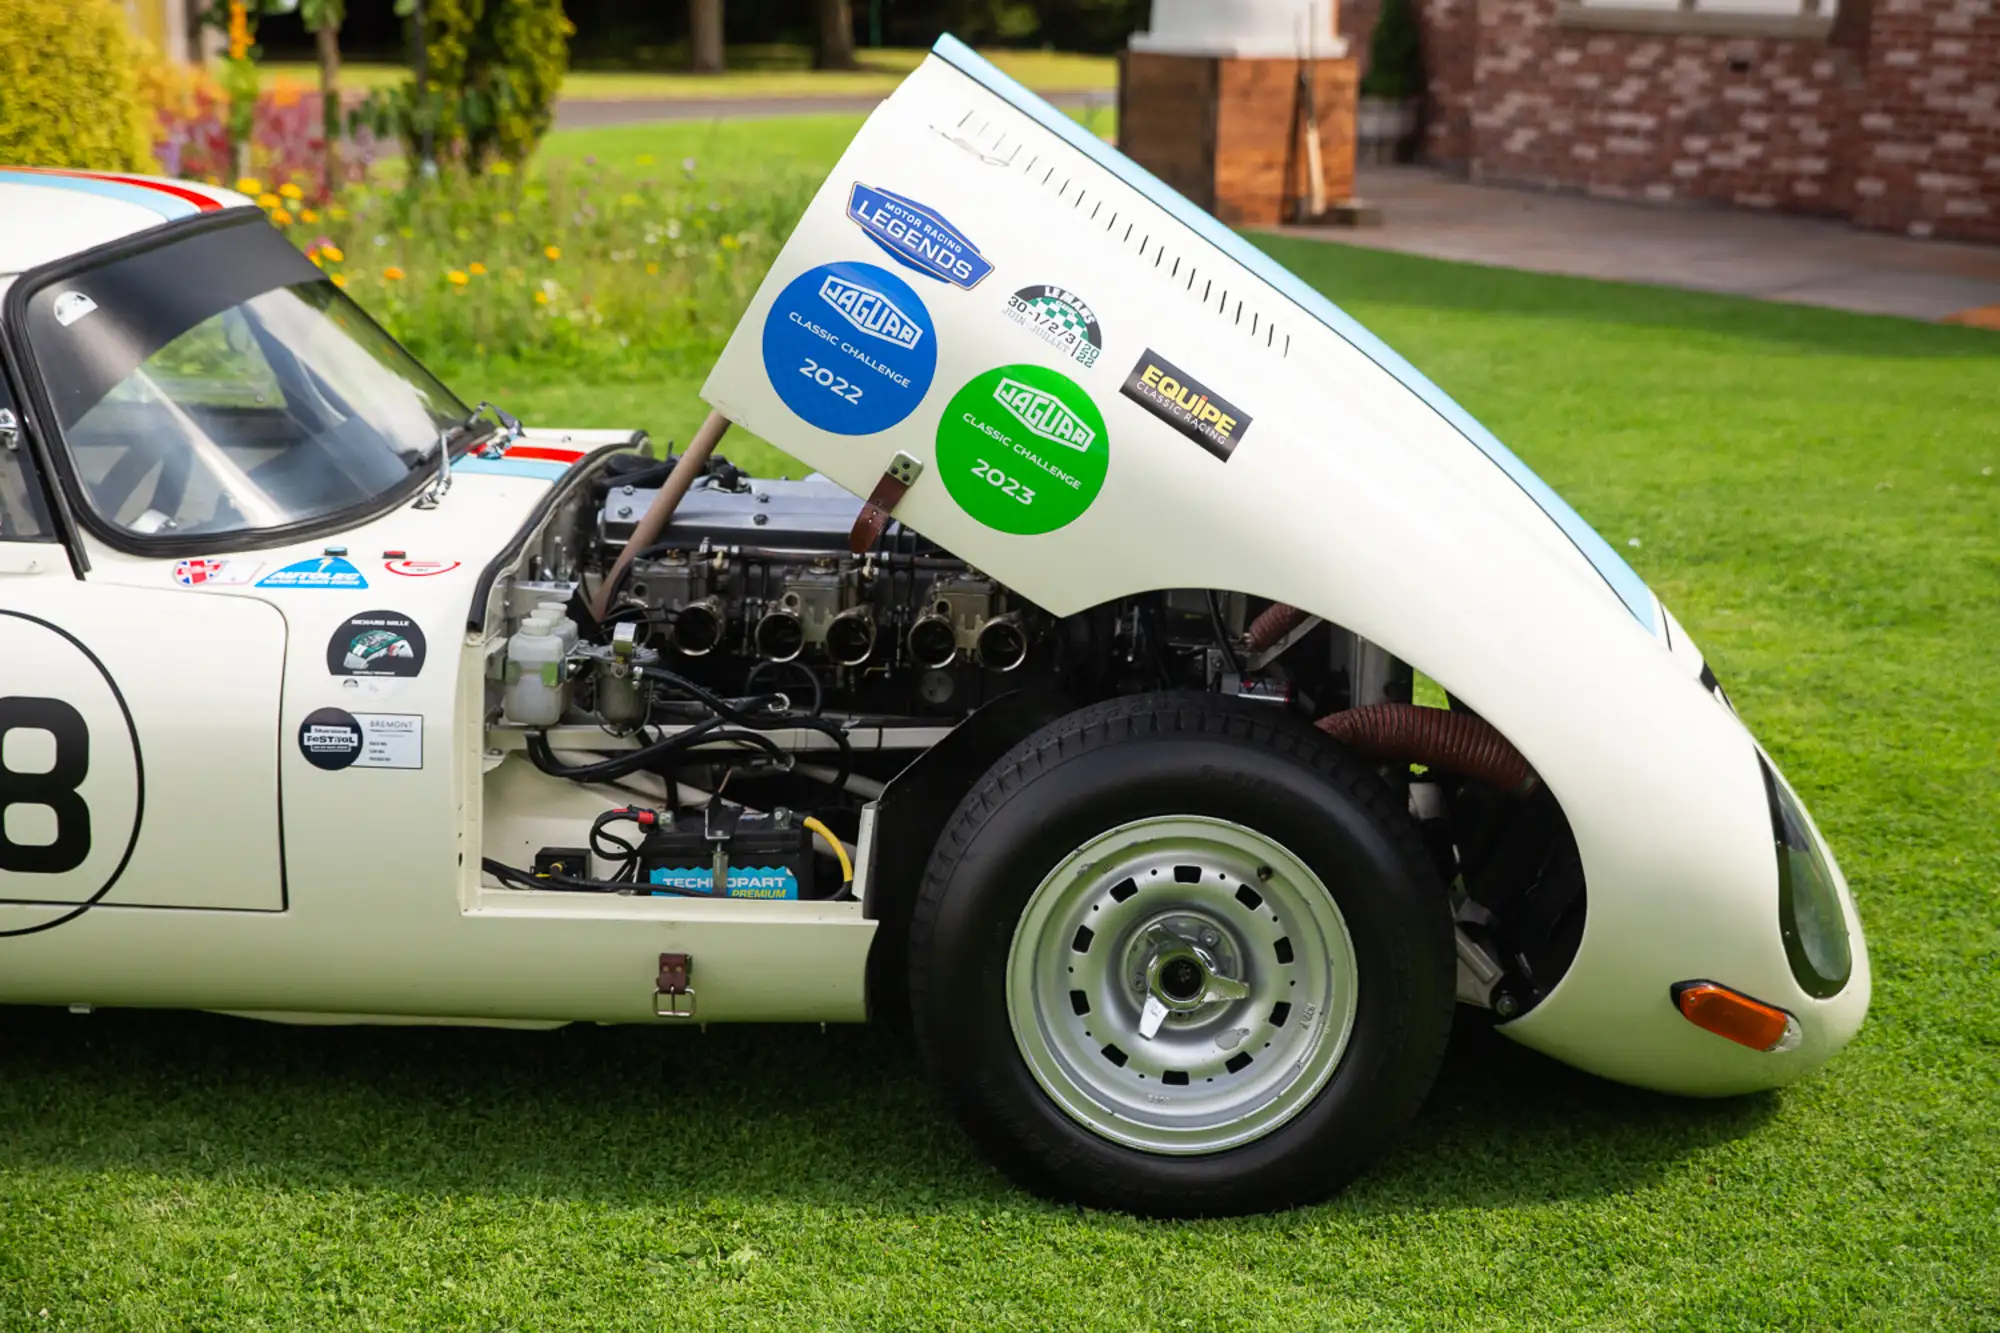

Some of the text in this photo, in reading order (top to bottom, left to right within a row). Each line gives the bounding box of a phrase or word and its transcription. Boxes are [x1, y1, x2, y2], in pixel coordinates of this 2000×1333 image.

[857, 200, 973, 280] LEGENDS
[885, 202, 962, 253] MOTOR RACING
[825, 285, 914, 342] JAGUAR
[789, 312, 911, 388] CLASSIC CHALLENGE
[799, 358, 864, 405] 2022
[1000, 387, 1087, 445] JAGUAR
[1136, 381, 1227, 445] CLASSIC RACING
[963, 412, 1082, 489] CLASSIC CHALLENGE
[971, 458, 1036, 505] 2023
[370, 720, 412, 728] BREMONT
[662, 877, 786, 889] TECHOPART
[731, 889, 787, 899] PREMIUM
